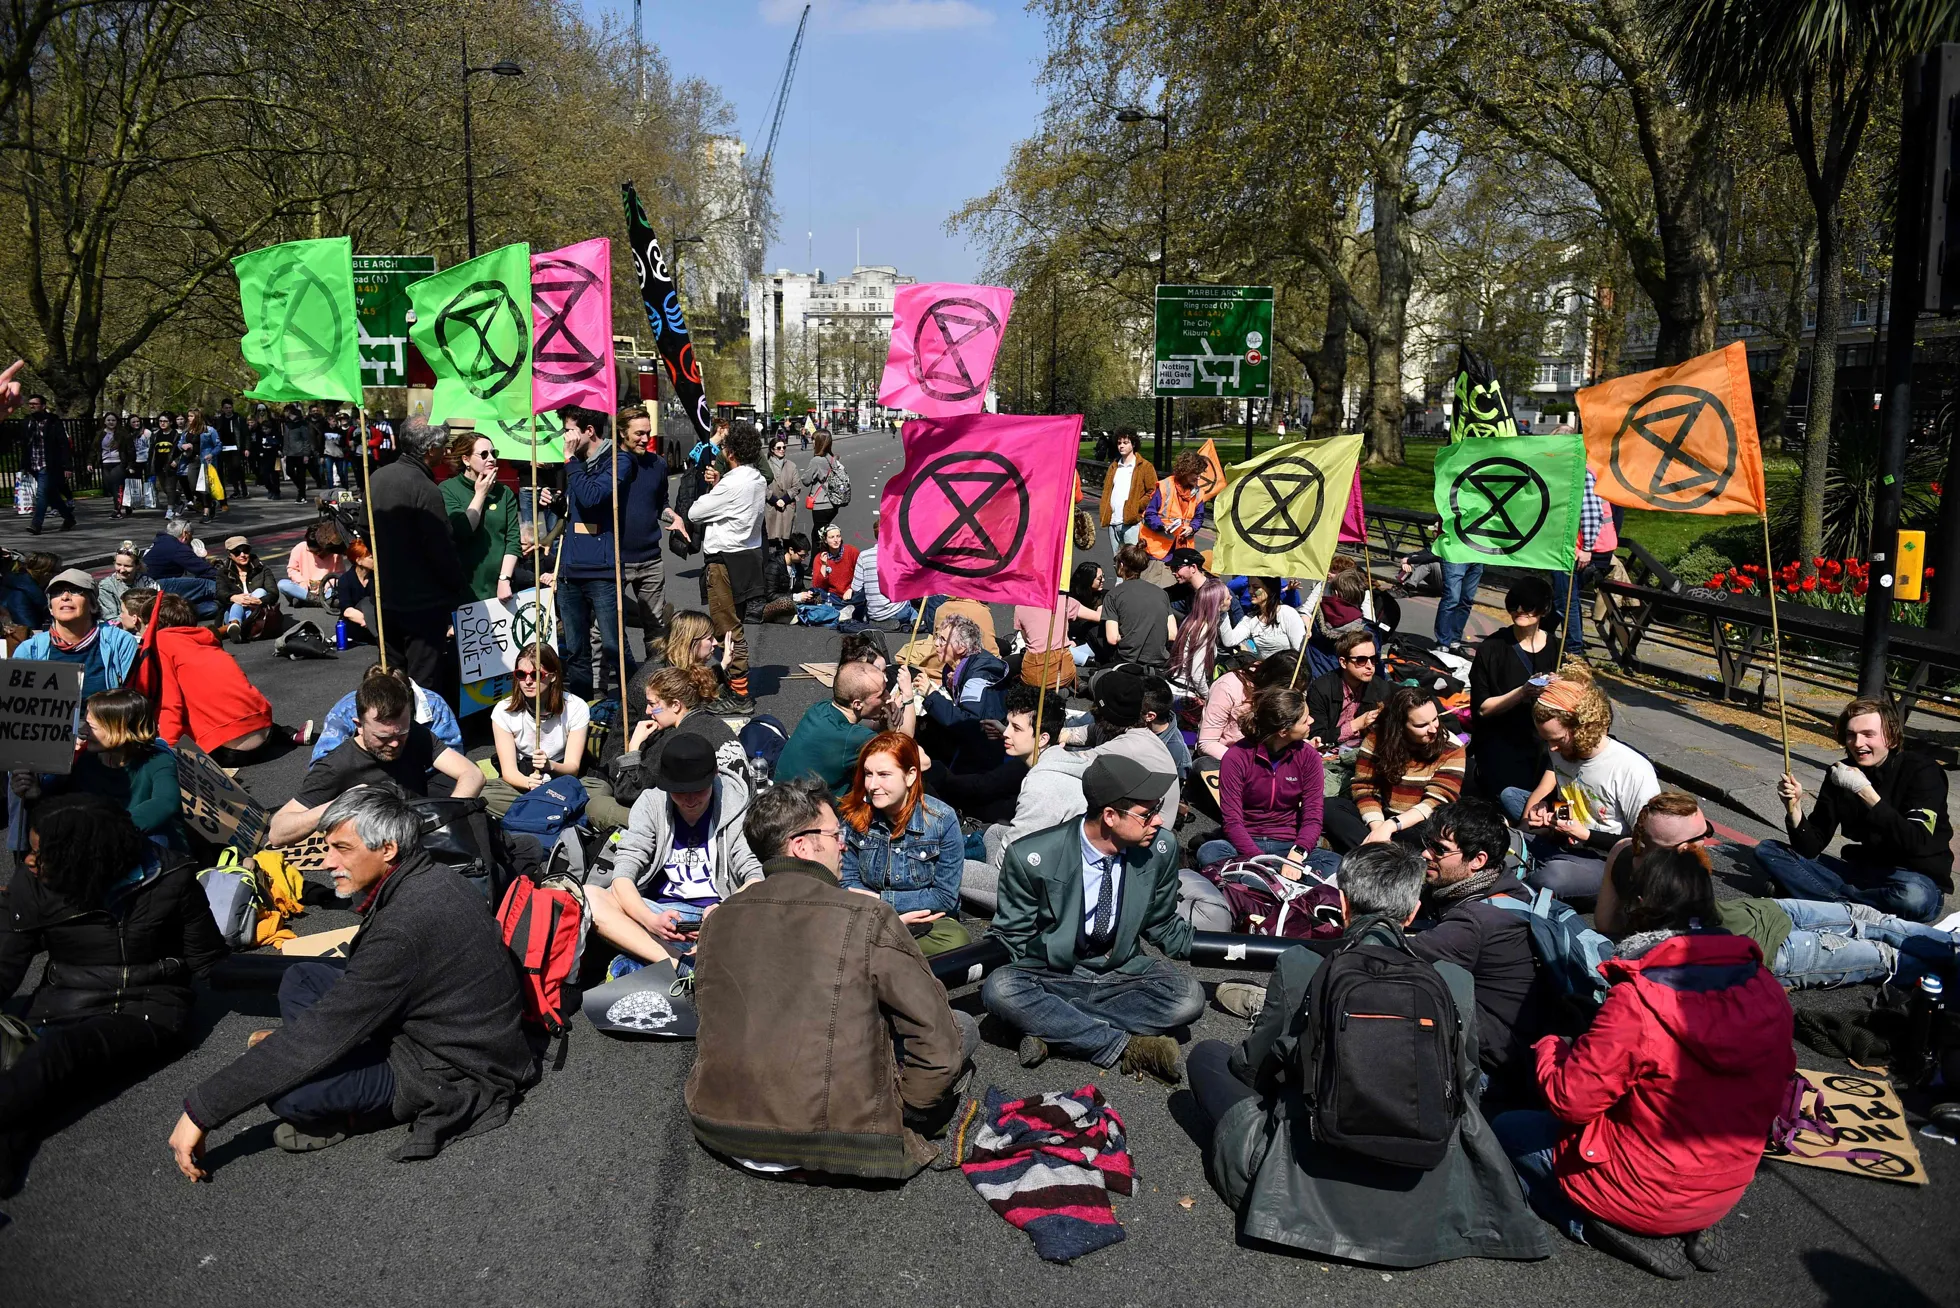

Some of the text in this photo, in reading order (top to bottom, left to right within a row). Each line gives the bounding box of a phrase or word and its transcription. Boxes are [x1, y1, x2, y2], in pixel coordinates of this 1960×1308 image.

[372, 260, 398, 268] ARCH
[371, 275, 389, 283] (N)
[1188, 288, 1219, 296] MARBLE
[1184, 302, 1200, 310] Ring
[1219, 302, 1234, 310] (N)
[1197, 320, 1212, 328] City
[1162, 363, 1190, 371] Notting
[1159, 378, 1181, 386] A402
[459, 605, 482, 678] PLANET
[475, 618, 492, 657] OUR
[490, 618, 508, 653] RIP
[8, 669, 59, 690] BE A
[0, 696, 77, 720] WORTHY
[0, 722, 73, 742] NCESTOR
[197, 775, 221, 835] CHAOS
[1834, 1124, 1904, 1143] NO
